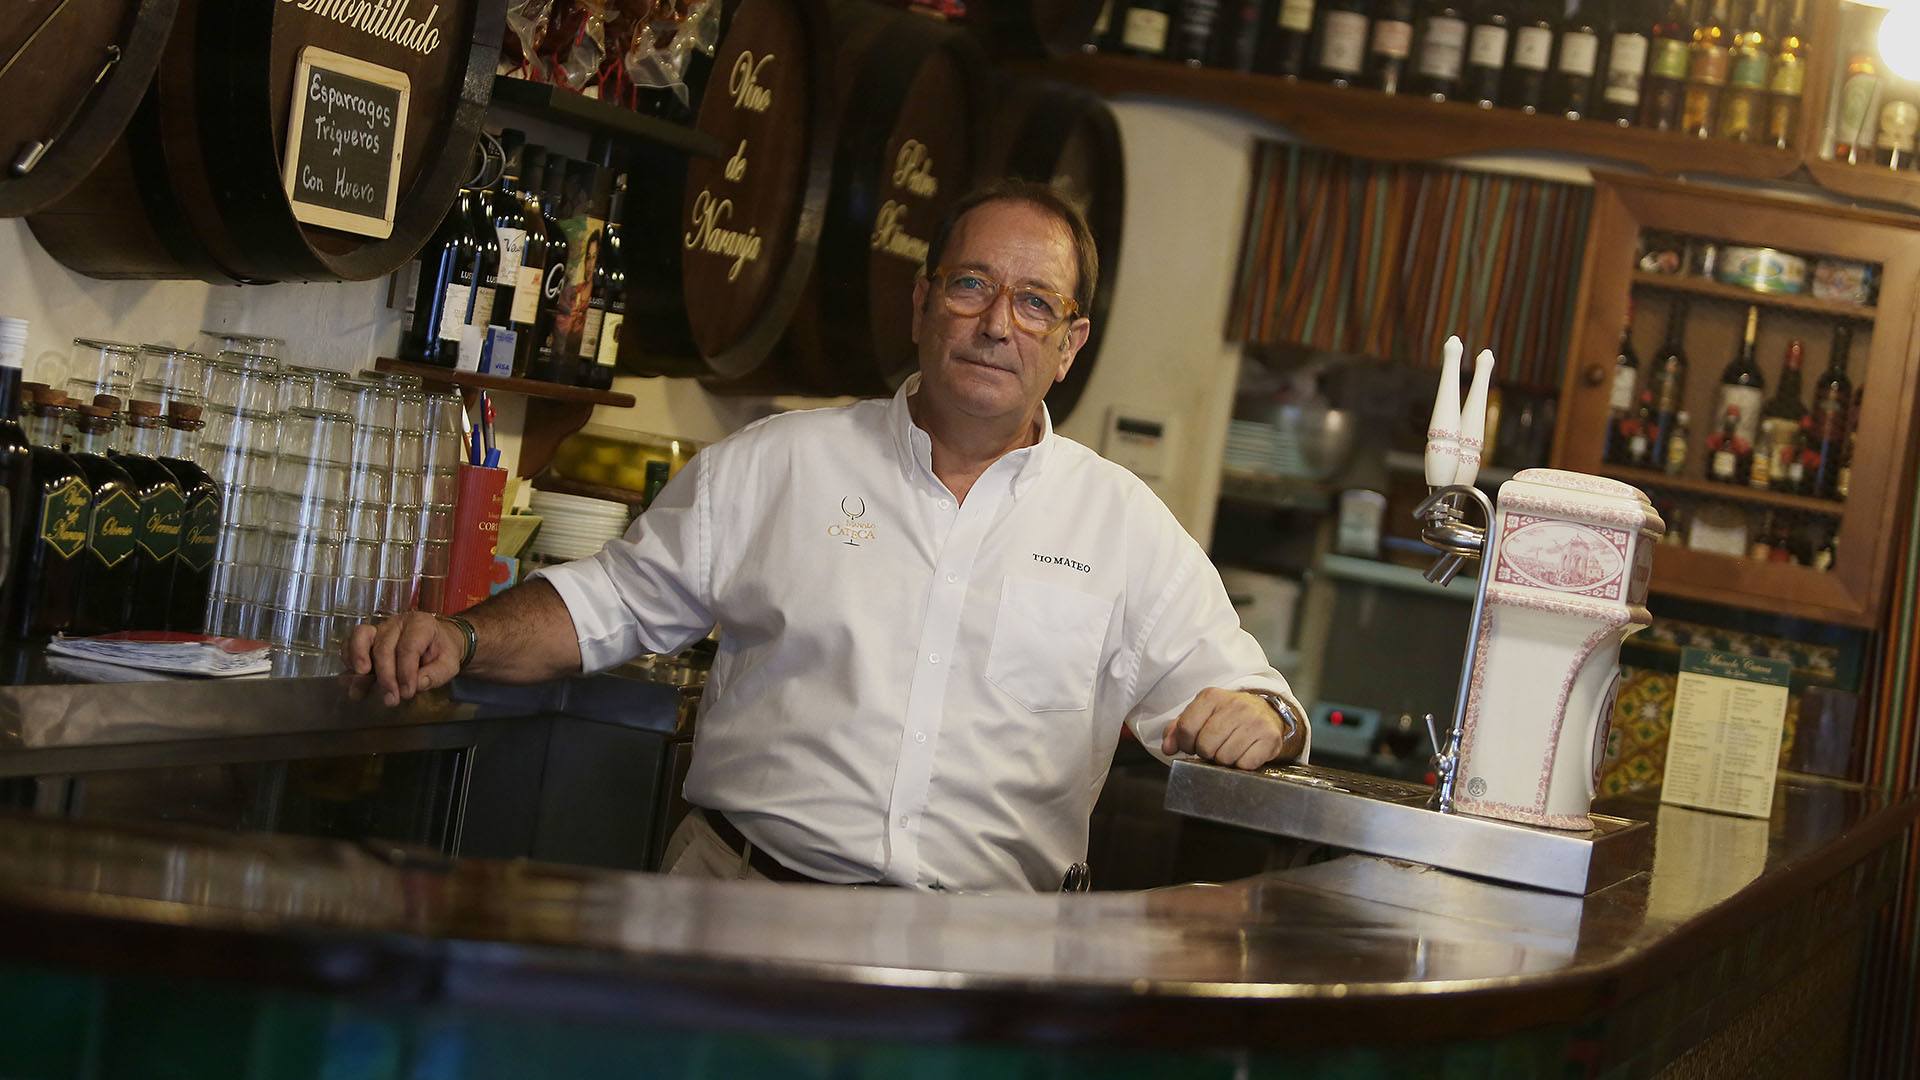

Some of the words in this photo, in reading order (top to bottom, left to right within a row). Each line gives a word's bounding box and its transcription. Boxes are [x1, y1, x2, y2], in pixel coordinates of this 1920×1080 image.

[282, 0, 440, 54] montillado
[310, 73, 391, 129] Esparragos
[729, 50, 775, 112] Vino
[315, 115, 380, 156] Trigueros
[724, 138, 747, 181] de
[302, 164, 324, 192] Con
[685, 190, 761, 282] Naranja
[1032, 553, 1052, 563] TIO
[1053, 557, 1091, 573] MATEO
